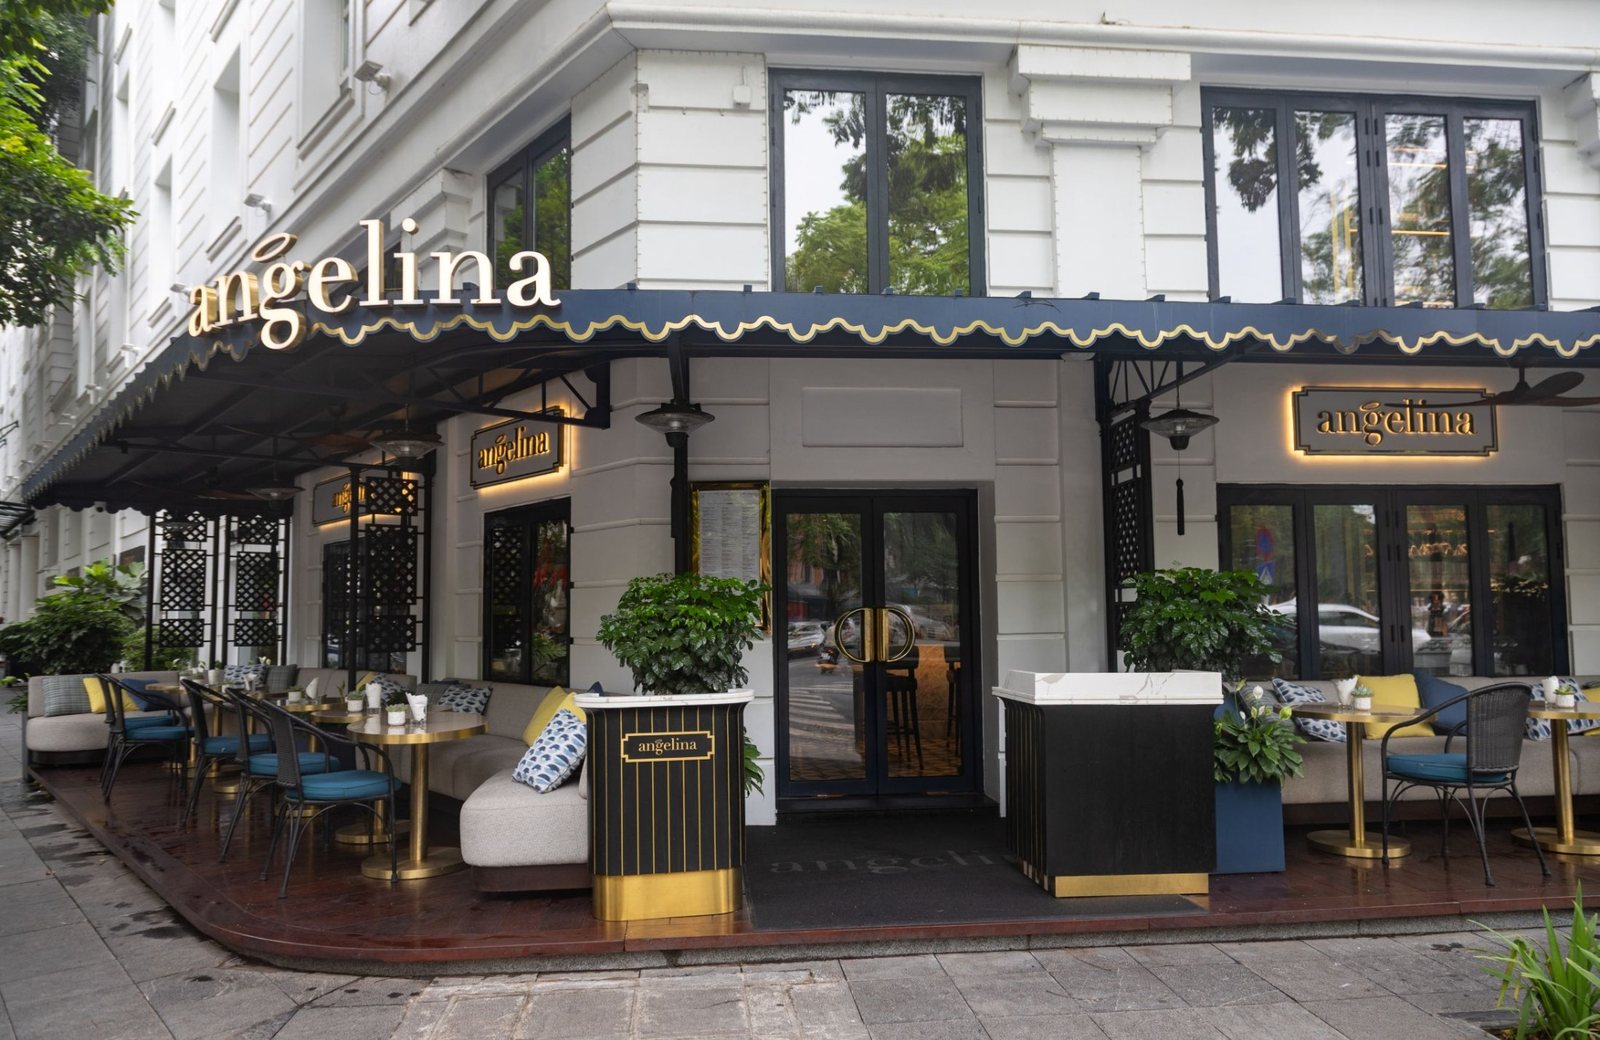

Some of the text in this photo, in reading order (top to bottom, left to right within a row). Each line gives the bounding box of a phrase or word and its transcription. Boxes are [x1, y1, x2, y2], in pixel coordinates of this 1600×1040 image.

[188, 218, 561, 350] angelina
[1316, 399, 1476, 446] angelina
[478, 426, 550, 475] angelina
[638, 737, 698, 756] angelina
